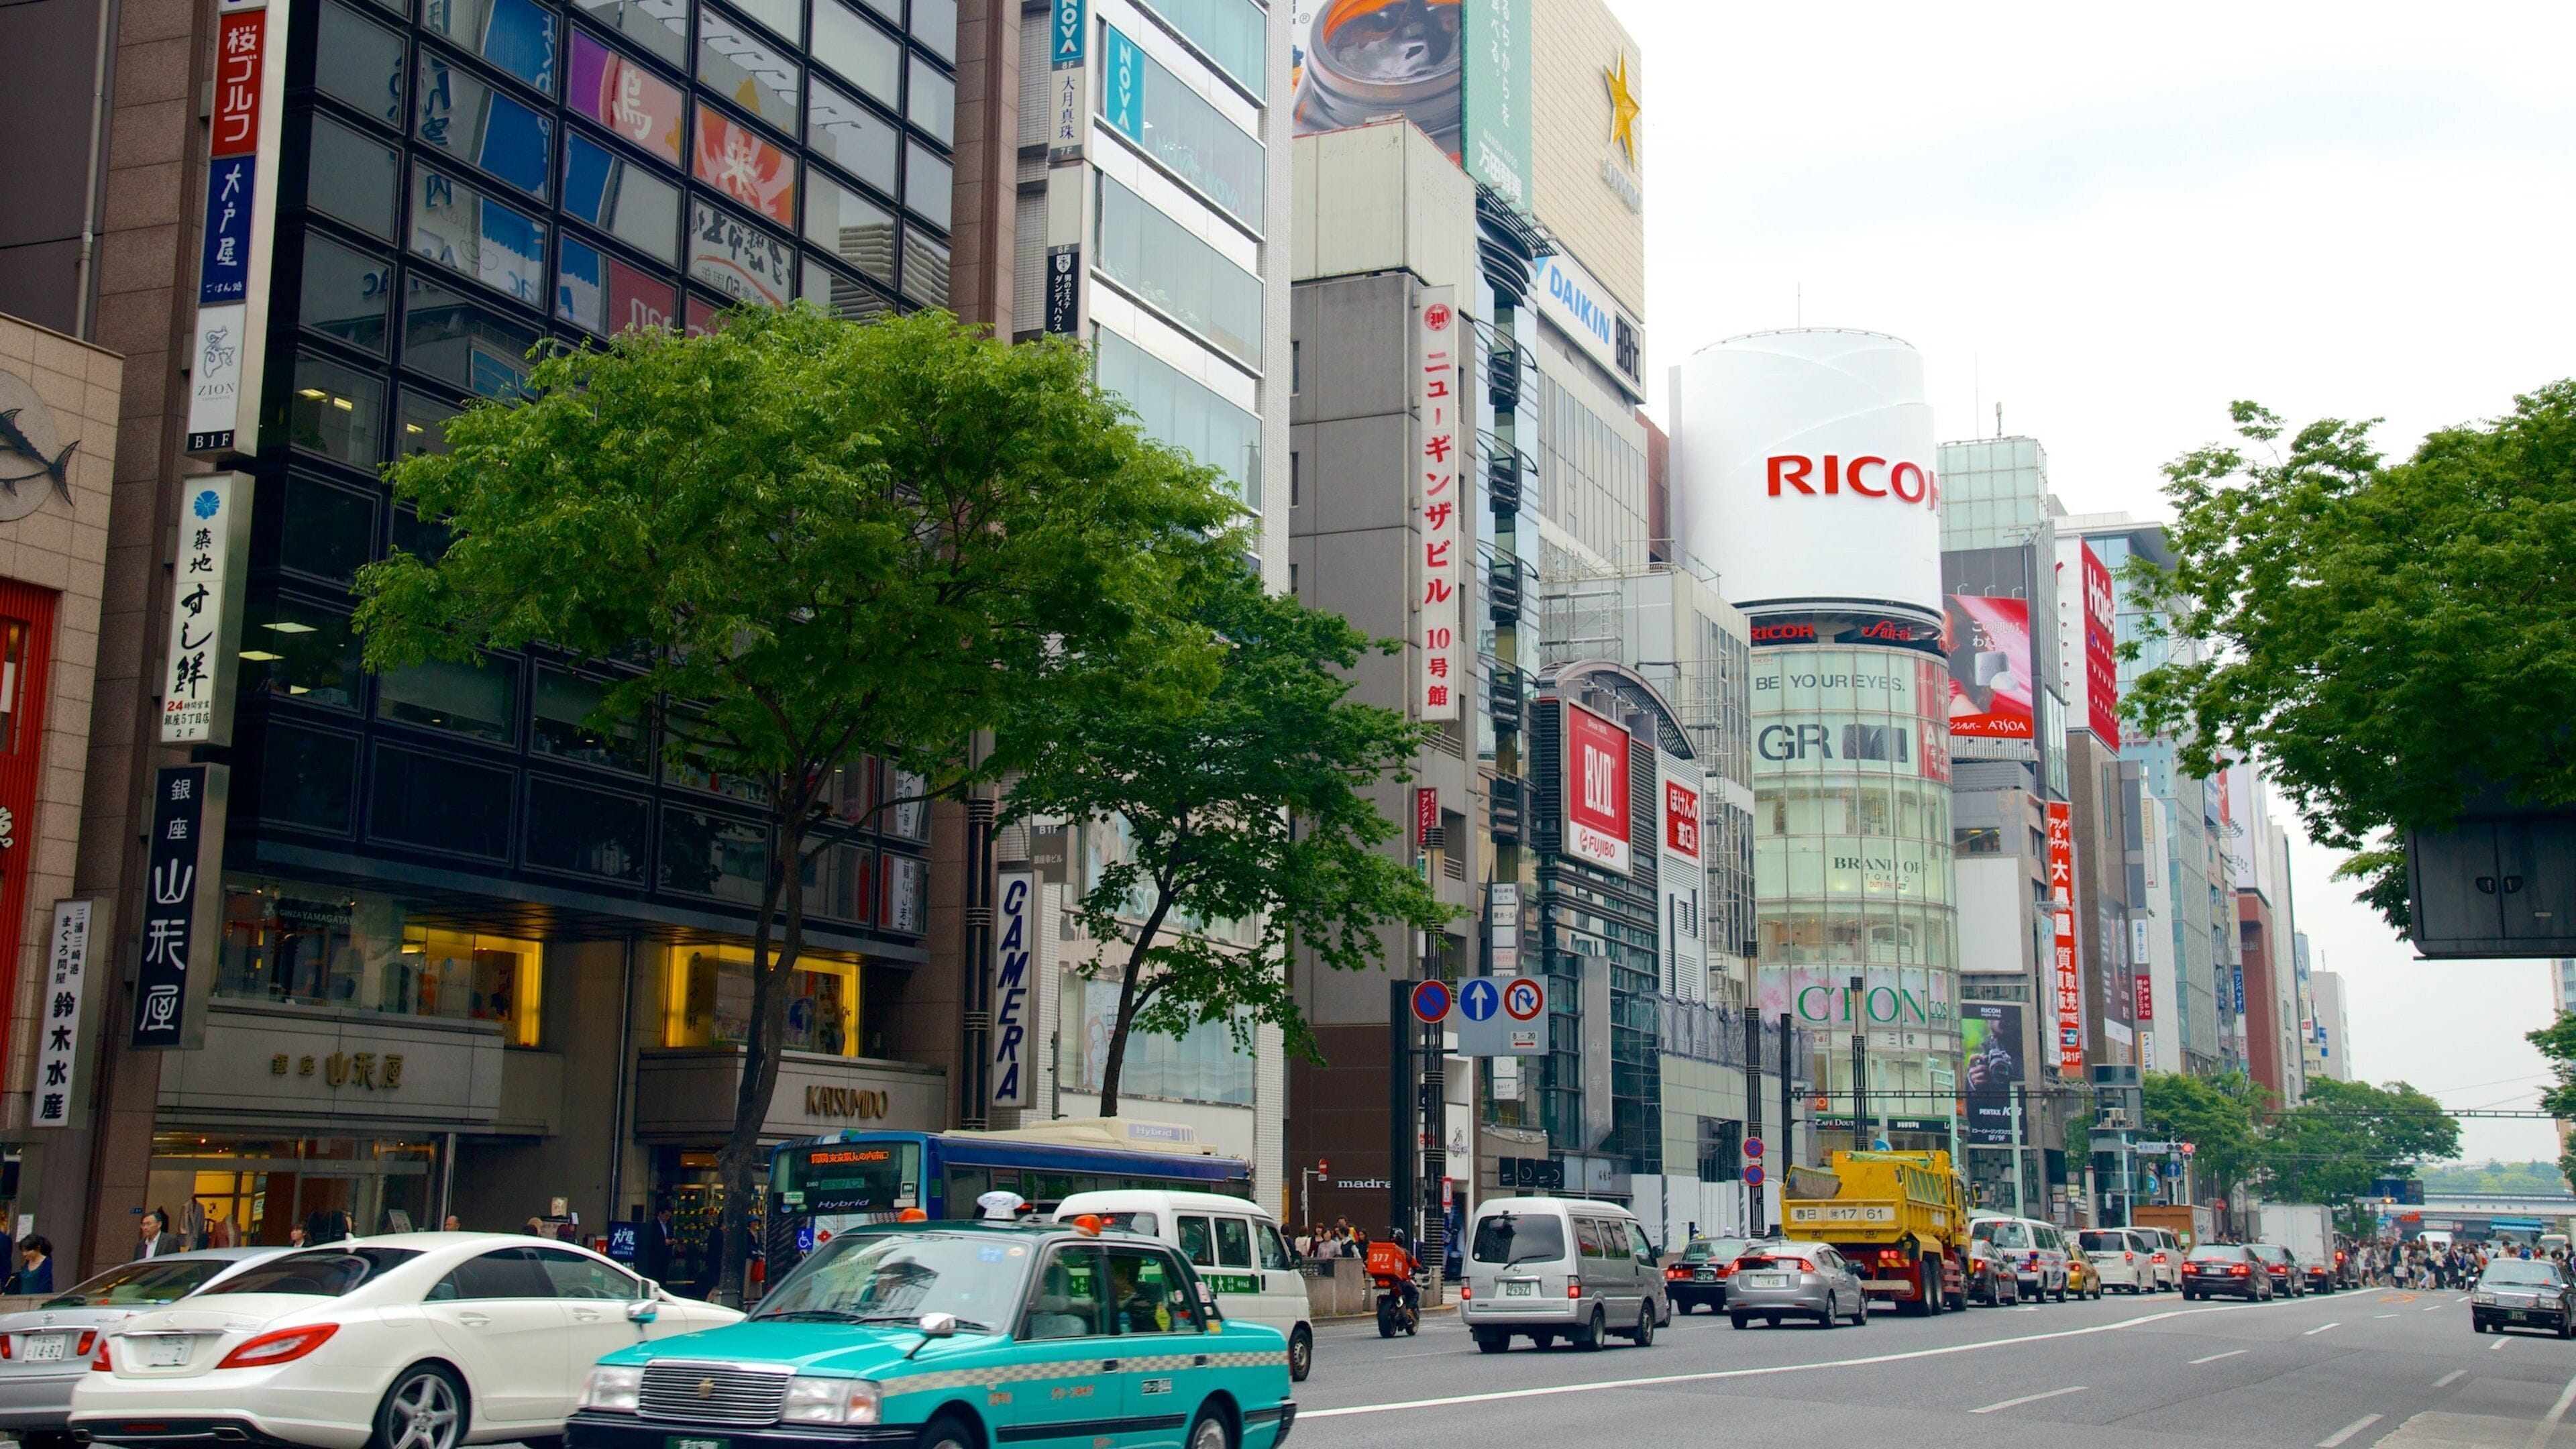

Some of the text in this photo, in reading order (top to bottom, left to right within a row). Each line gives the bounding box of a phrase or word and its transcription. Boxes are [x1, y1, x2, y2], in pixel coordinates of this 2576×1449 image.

[1062, 61, 1074, 70] 8F
[223, 24, 258, 142] 桜ゴルフ
[1118, 41, 1131, 131] NOVA
[1059, 75, 1075, 140] 大月真珠
[1060, 148, 1073, 156] 7F
[217, 163, 243, 267] 大戸屋
[1057, 245, 1070, 254] 6F
[1054, 274, 1063, 331] ダンディハウス
[1550, 264, 1611, 345] DAIKIN
[198, 383, 235, 396] ZION
[194, 433, 229, 449] B1F
[1767, 455, 1941, 517] RICOH
[1424, 352, 1452, 706] ニューギンザビル 10号館
[2088, 563, 2114, 635] Haie
[1751, 624, 1814, 640] RICOH
[1756, 676, 1780, 690] BE
[1790, 674, 1847, 688] YOUR
[1987, 718, 2027, 733] ARSOA
[1758, 724, 1833, 761] GR
[1585, 744, 1615, 818] B.V.D.
[1589, 836, 1615, 858] FUJIBO
[996, 880, 1028, 1099] CAMERA
[40, 991, 76, 1120] 鈴木水産
[805, 1084, 888, 1119] KATSUMIDO
[2002, 1107, 2023, 1116] K3
[1136, 1126, 1173, 1138] Hybrid
[1835, 1119, 1855, 1127] DOUT
[818, 1199, 870, 1209] Hybrid
[1796, 1209, 1817, 1220] 春日
[1841, 1209, 1857, 1219] 17
[1866, 1209, 1883, 1220] 61
[1373, 1253, 1390, 1263] 377
